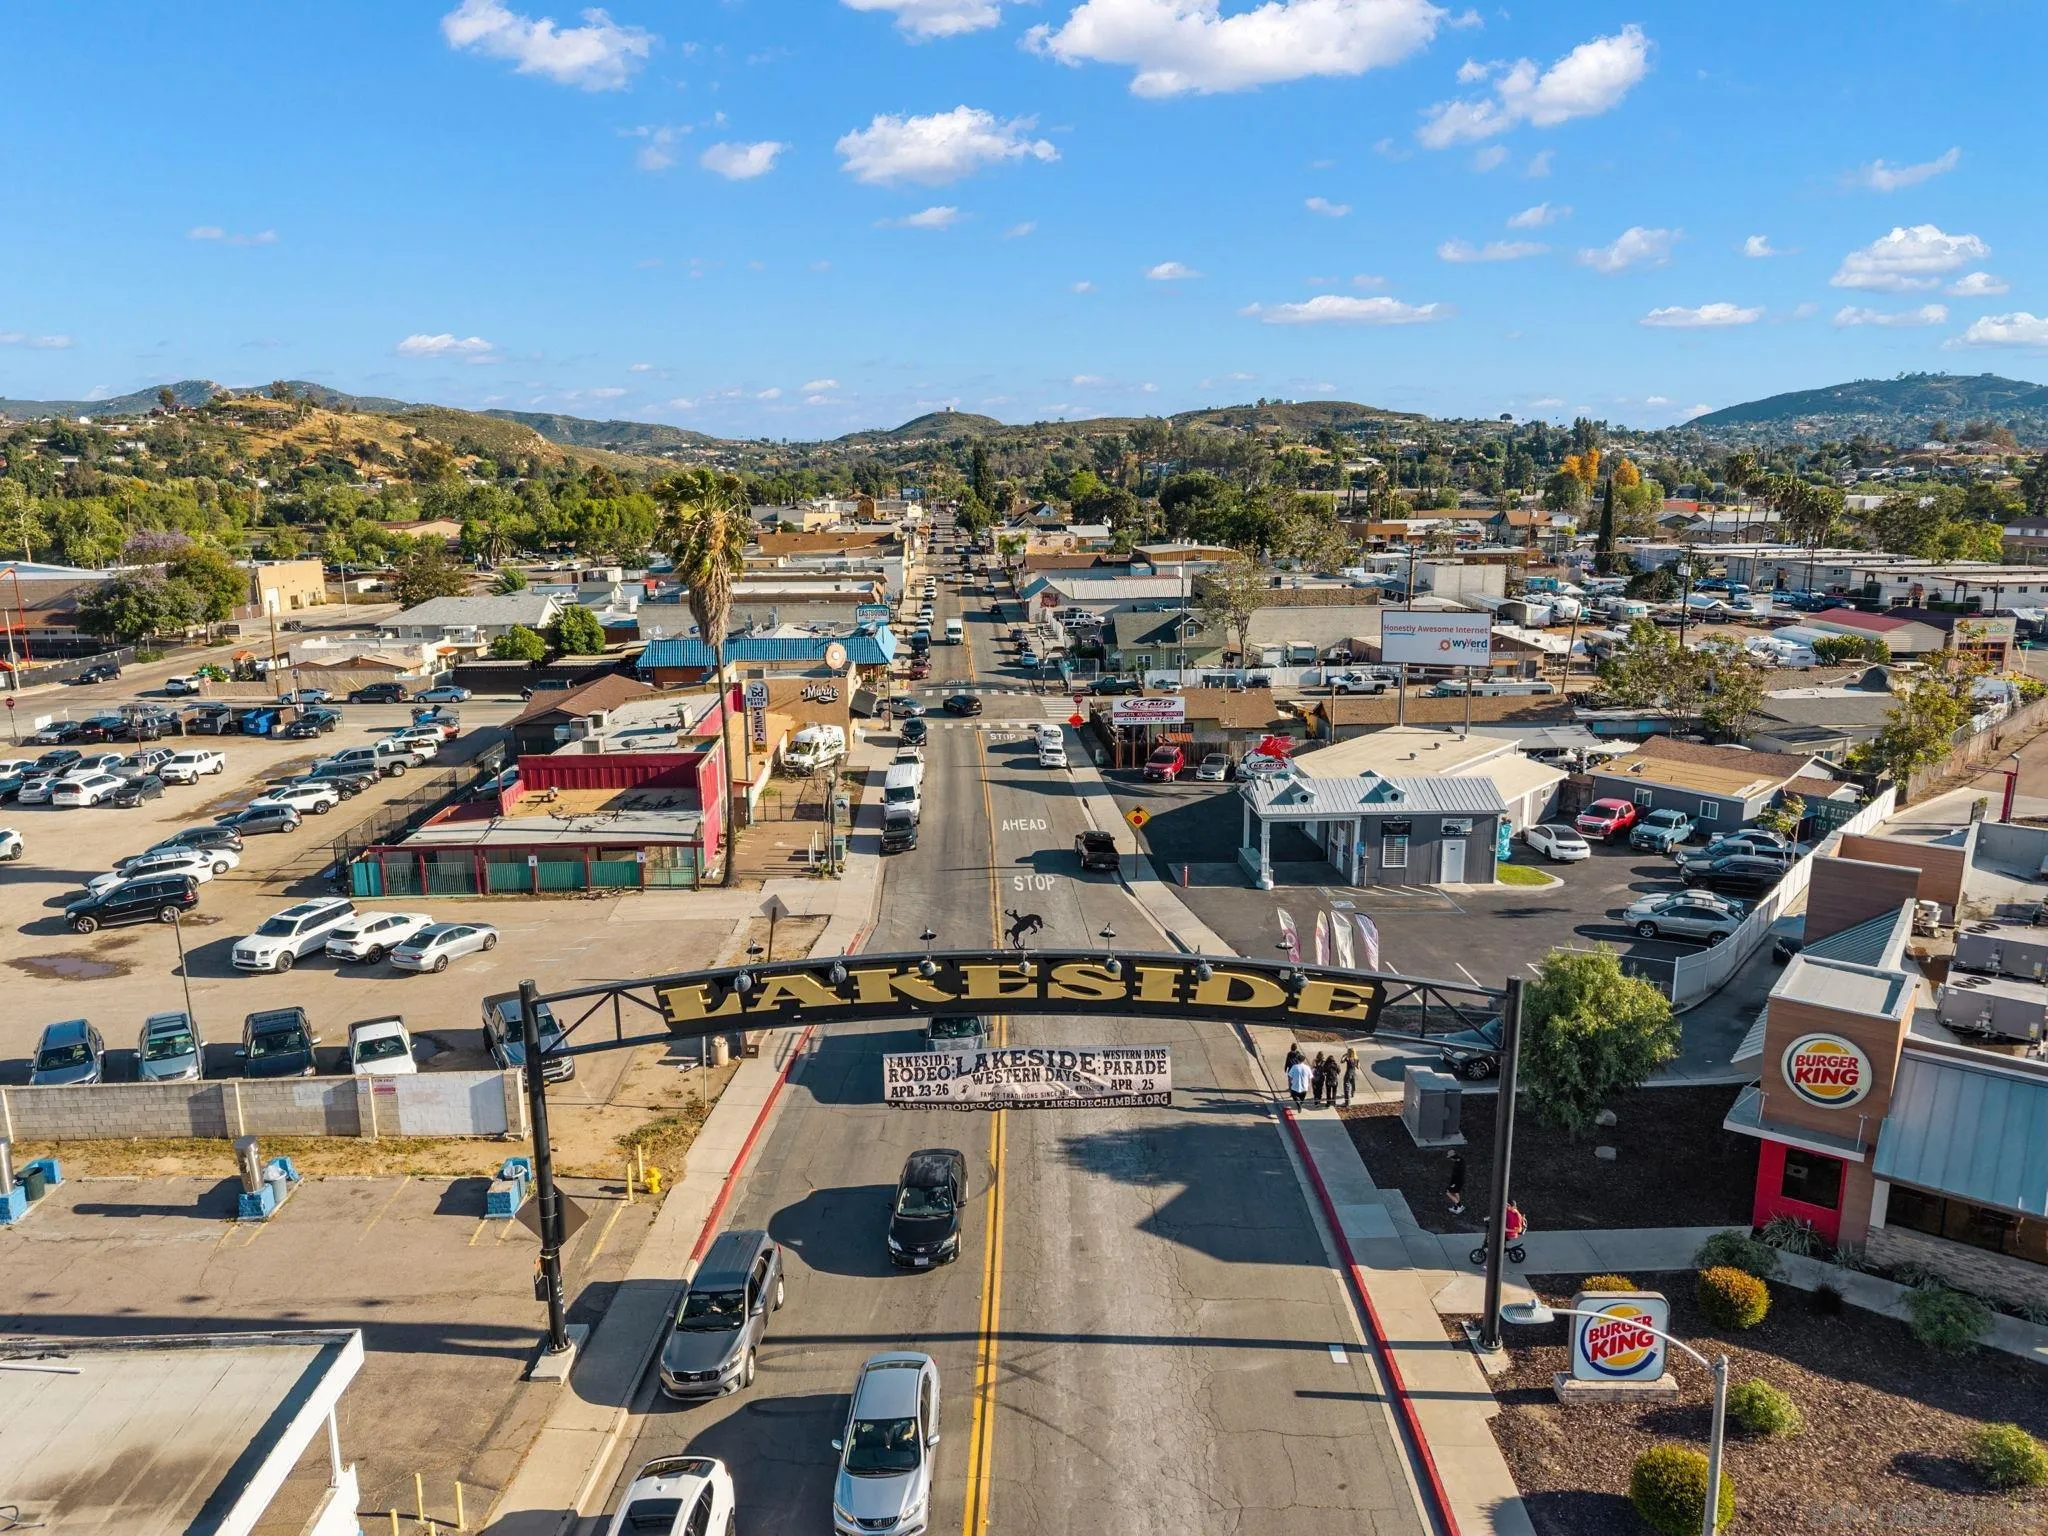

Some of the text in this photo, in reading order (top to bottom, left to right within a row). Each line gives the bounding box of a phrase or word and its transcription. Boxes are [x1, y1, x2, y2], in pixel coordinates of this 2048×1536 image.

[1383, 624, 1489, 634] Honestly Awesome Internet
[805, 686, 840, 701] Mary's
[990, 733, 1016, 741] STOP
[1002, 818, 1047, 832] AHEAD
[1014, 875, 1056, 892] STOP
[658, 963, 1375, 1022] LAKESIDE
[889, 1054, 951, 1068] LAKESIDE
[1102, 1049, 1167, 1060] WESTERN DAYS
[1794, 1054, 1859, 1069] BURGER
[955, 1049, 1096, 1079] LAKESIDE
[1103, 1060, 1167, 1076] PARADE
[888, 1066, 951, 1083] RODEO
[971, 1067, 1081, 1085] WESTERN DAYS
[1794, 1067, 1860, 1086] KING
[1044, 1093, 1168, 1109] LAKESIDECHAMBER.ORG
[1588, 1315, 1653, 1344] BURGER
[1590, 1330, 1655, 1362] KING
